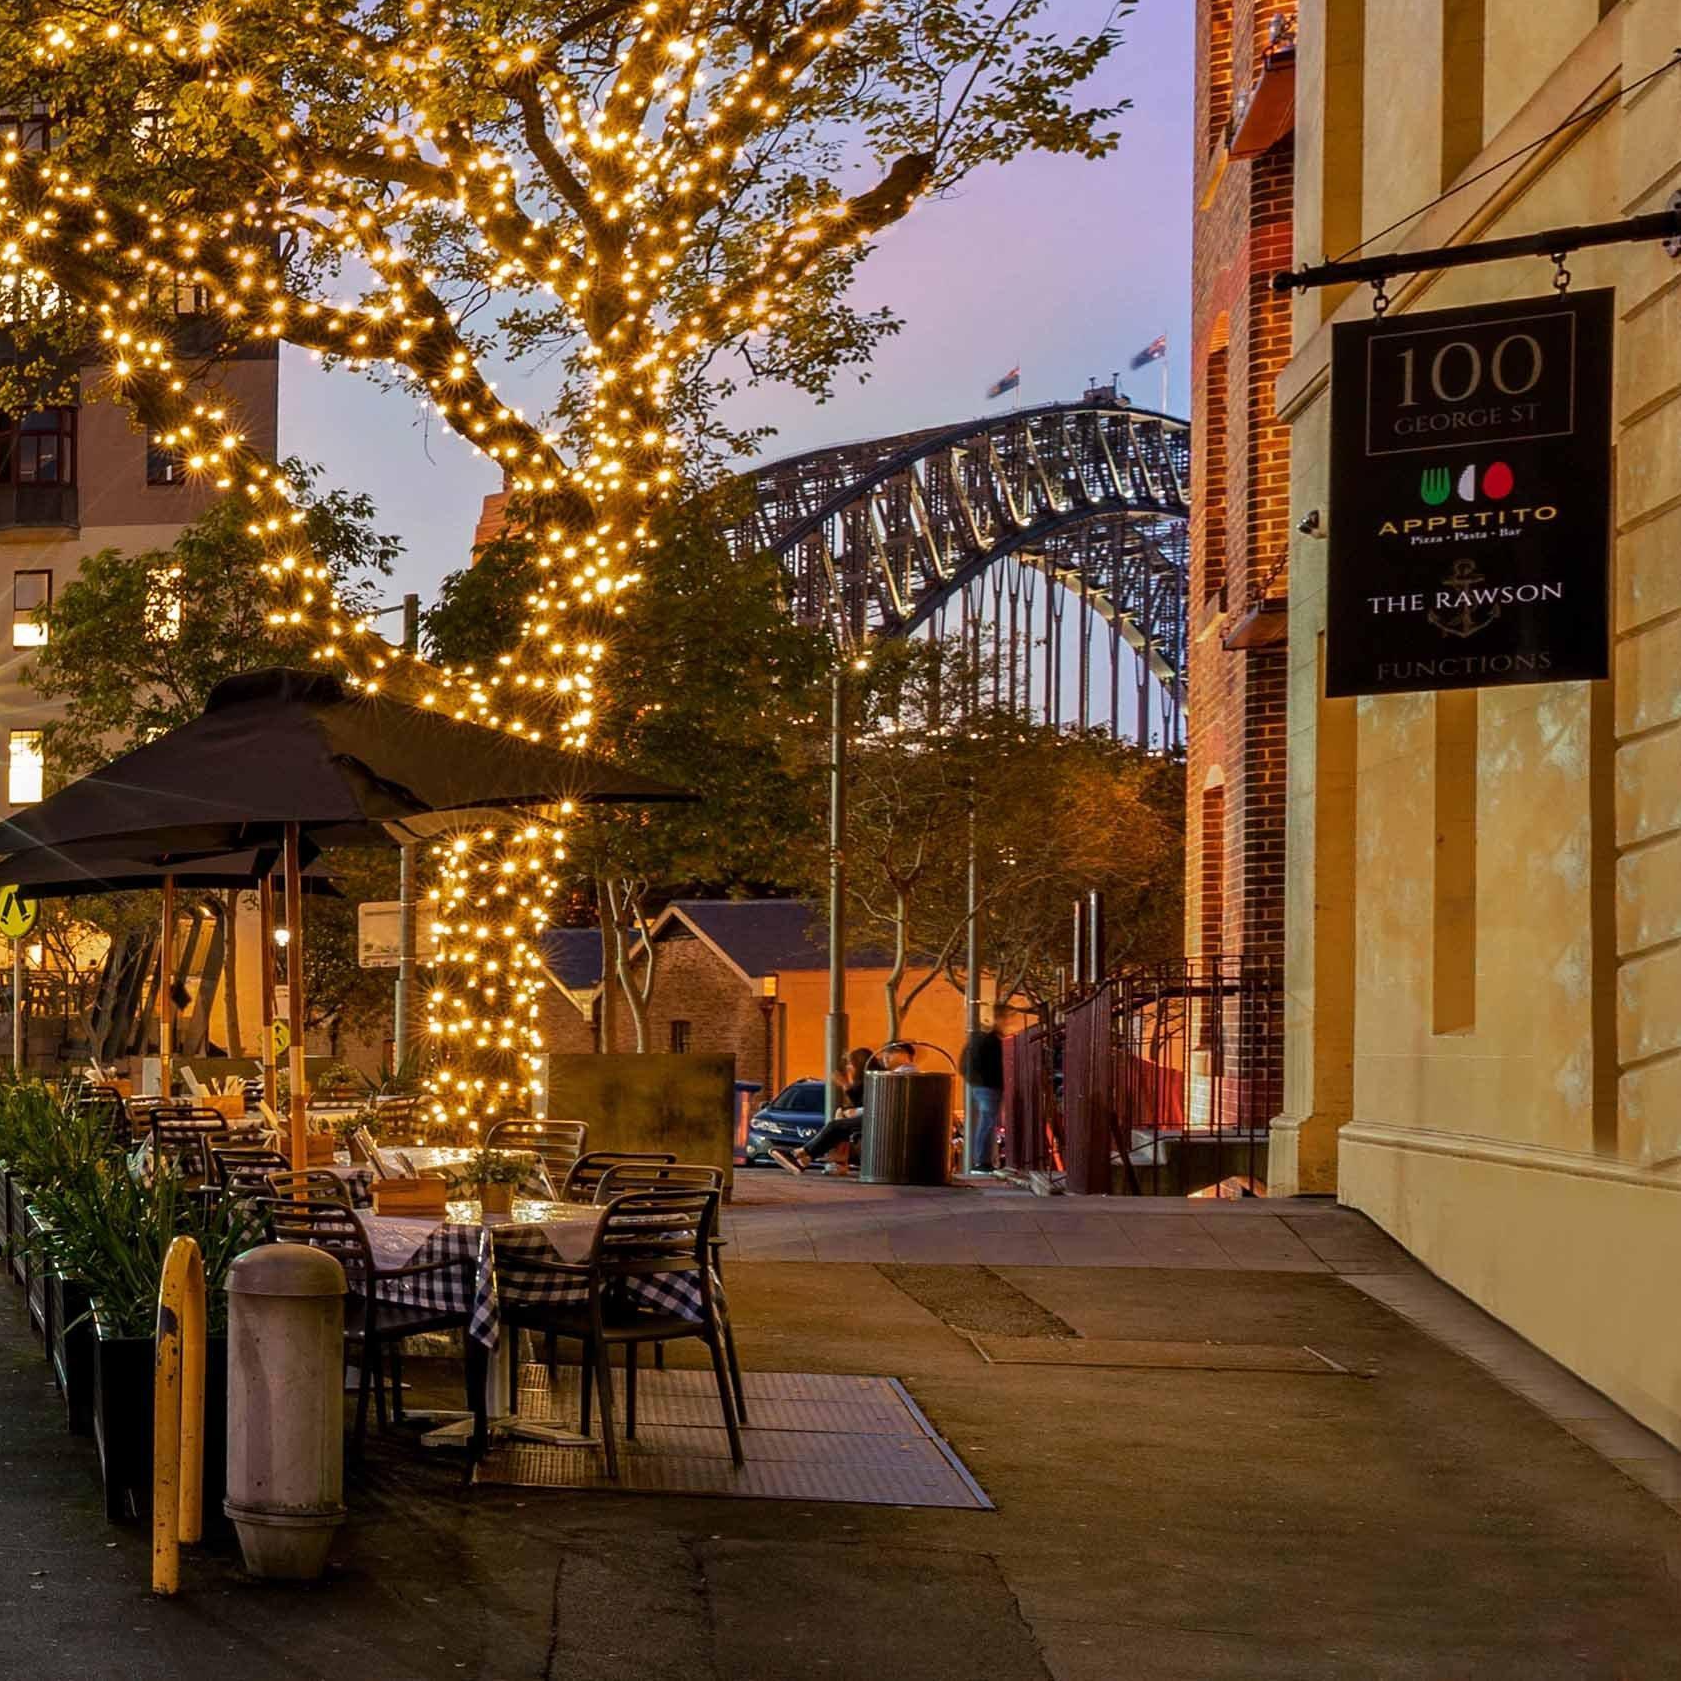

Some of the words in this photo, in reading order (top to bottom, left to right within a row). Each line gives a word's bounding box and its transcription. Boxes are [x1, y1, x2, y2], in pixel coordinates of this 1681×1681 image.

[1397, 334, 1542, 407] 100
[1394, 406, 1502, 436] GEORGE
[1510, 403, 1542, 423] ST
[1378, 506, 1558, 536] APPETITO
[1410, 533, 1444, 546] Pizza
[1454, 530, 1488, 542] Pasta
[1499, 527, 1523, 537] Bar
[1367, 593, 1425, 614] THE
[1436, 582, 1563, 609] RAWSON
[1378, 651, 1552, 681] FUNCTIONS
